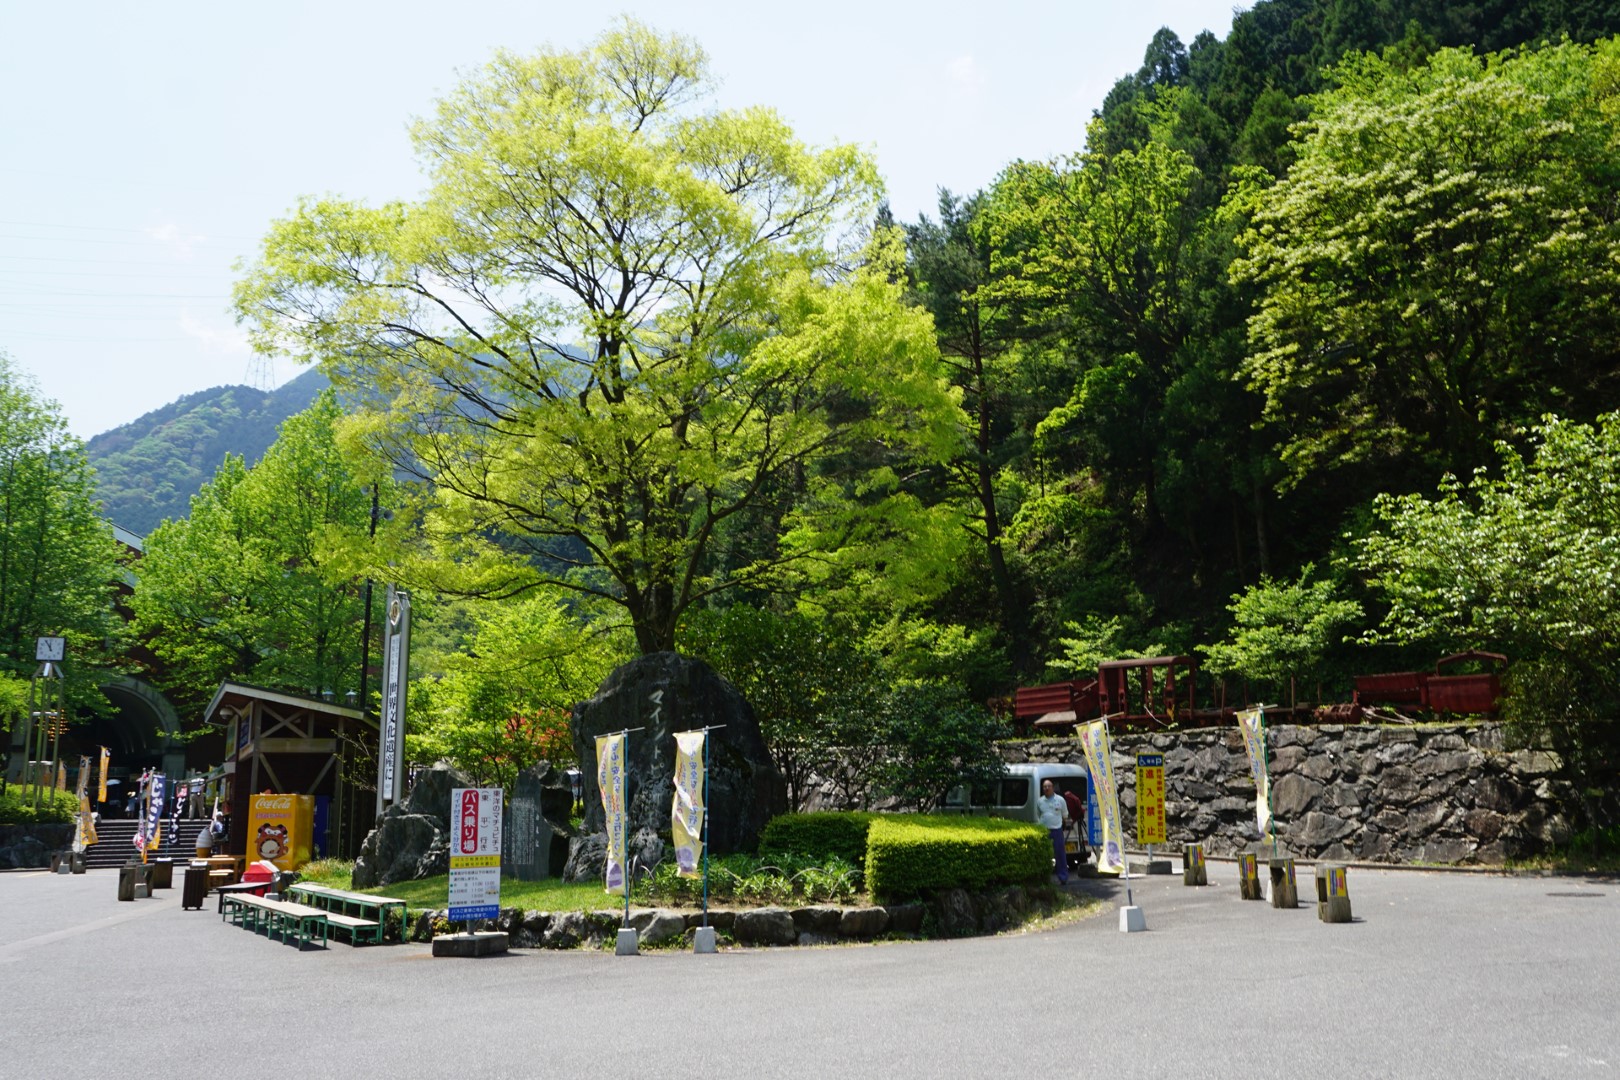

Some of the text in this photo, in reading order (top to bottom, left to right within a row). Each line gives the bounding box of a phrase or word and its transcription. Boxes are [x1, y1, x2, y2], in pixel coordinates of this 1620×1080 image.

[385, 683, 397, 780] 世界文化遺産に
[463, 792, 477, 852] バス乗り場
[1146, 768, 1156, 837] 進入禁止
